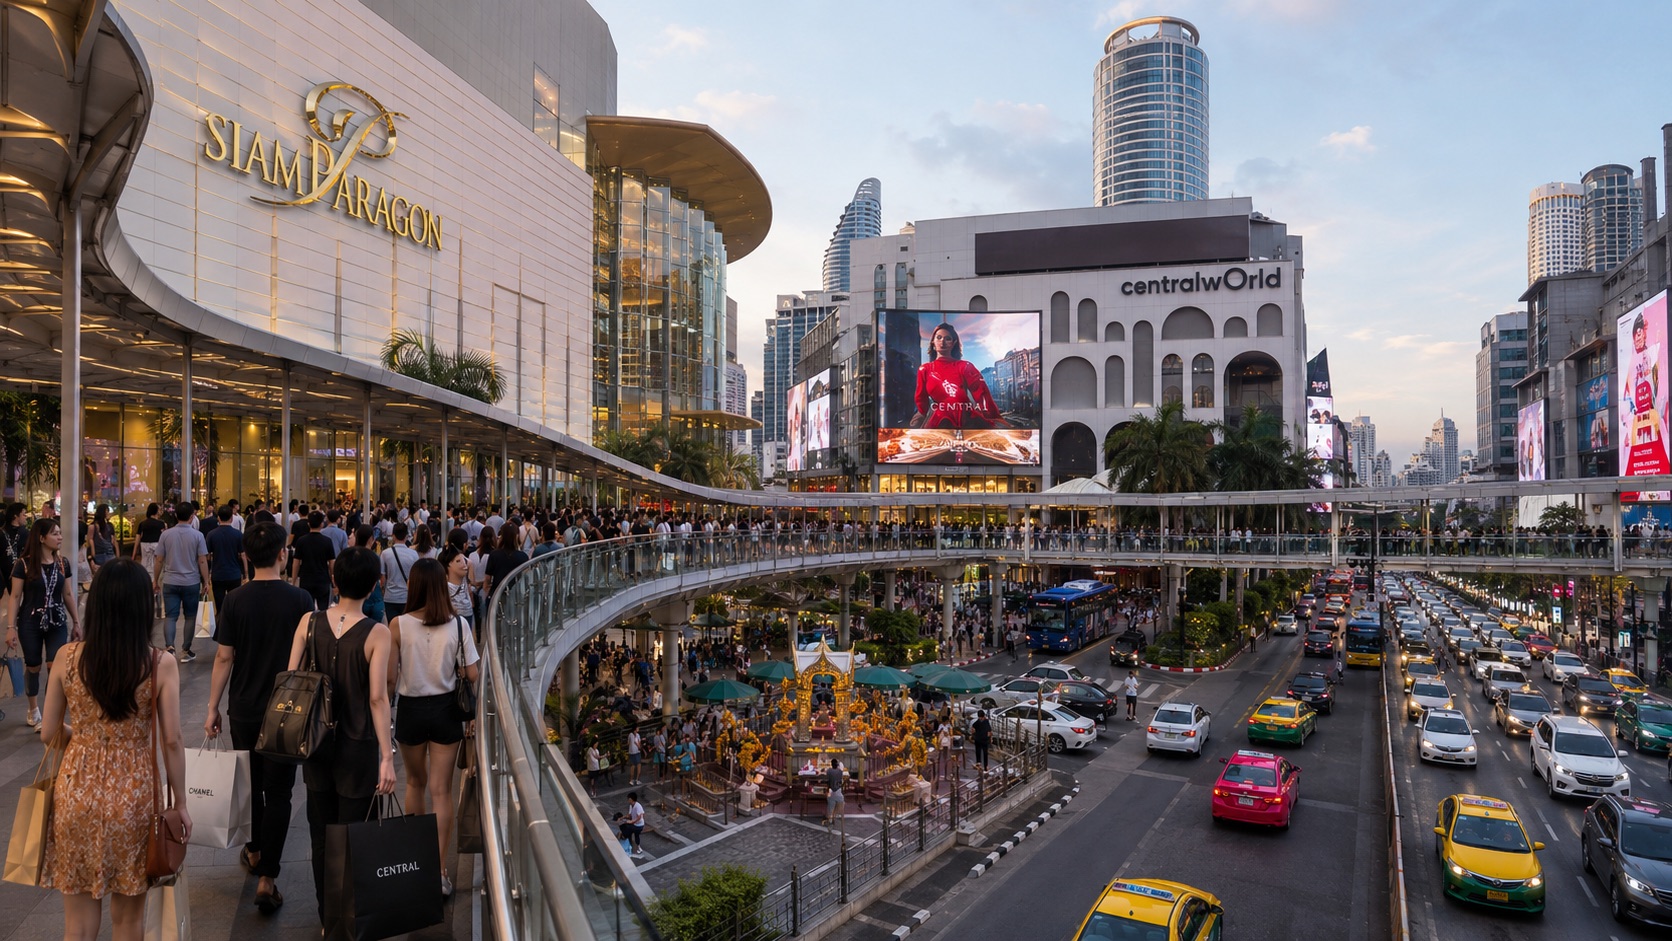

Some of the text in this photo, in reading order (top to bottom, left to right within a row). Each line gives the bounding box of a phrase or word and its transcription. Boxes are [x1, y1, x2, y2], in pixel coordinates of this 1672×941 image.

[204, 112, 443, 252] SIAM PARAGON
[376, 861, 420, 878] CENTRAL
